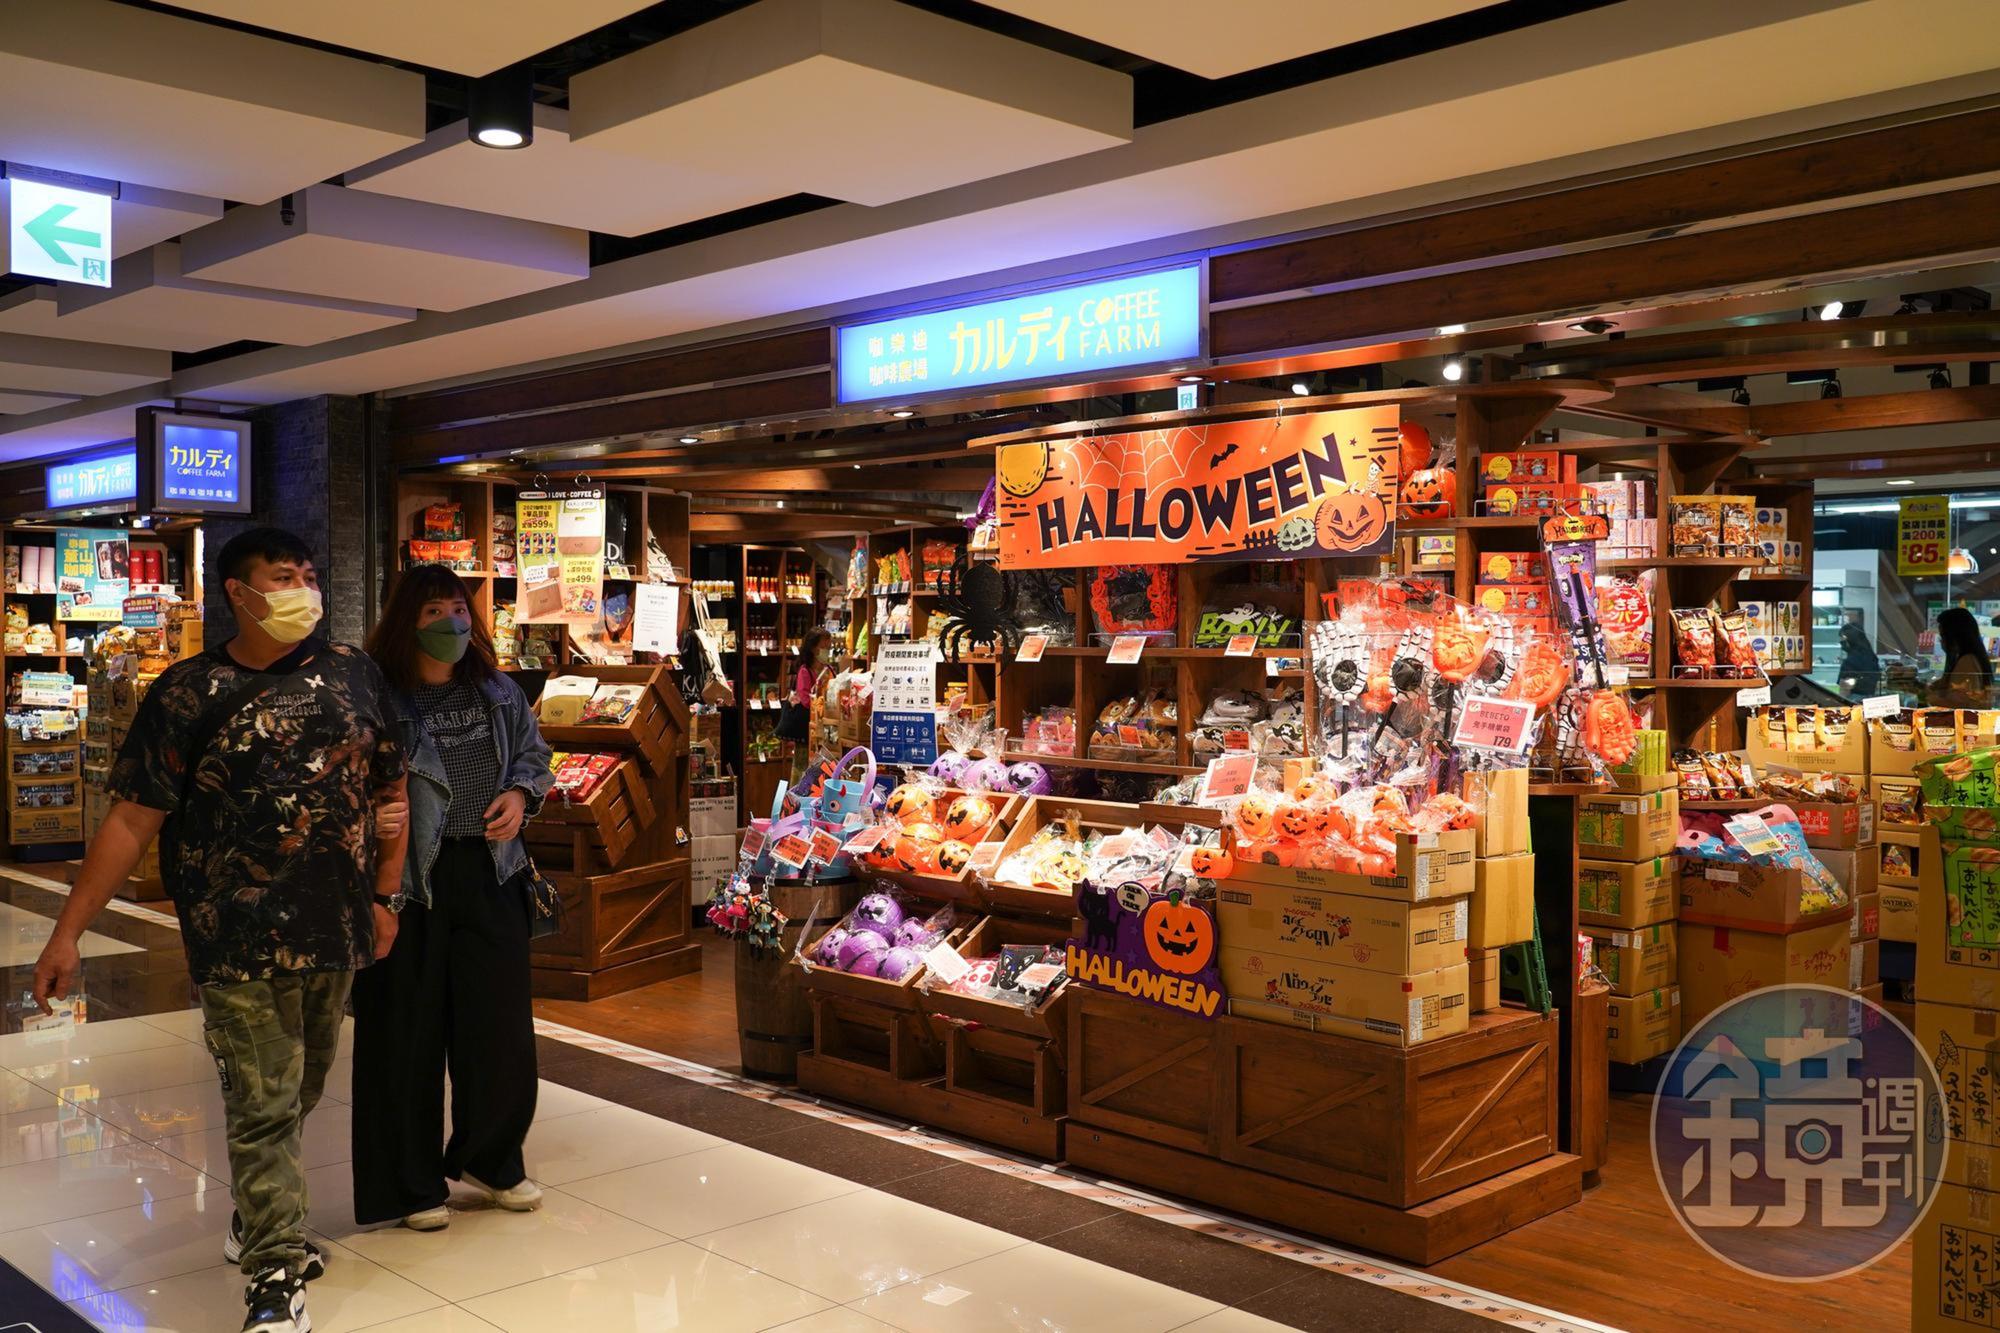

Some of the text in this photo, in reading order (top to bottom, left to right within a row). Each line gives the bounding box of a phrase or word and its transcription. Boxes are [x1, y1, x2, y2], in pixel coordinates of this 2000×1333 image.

[1078, 288, 1160, 328] COFFEE
[949, 306, 1072, 375] カルディ
[1080, 320, 1161, 358] FARM
[170, 446, 233, 469] カルディ
[177, 467, 225, 478] COFFEE FARM
[570, 490, 592, 498] COFFEE
[1036, 432, 1348, 554] HALLOWEEN
[1493, 735, 1512, 748] 179
[1233, 783, 1245, 795] 99
[1067, 945, 1221, 1017] HALLOWEEN
